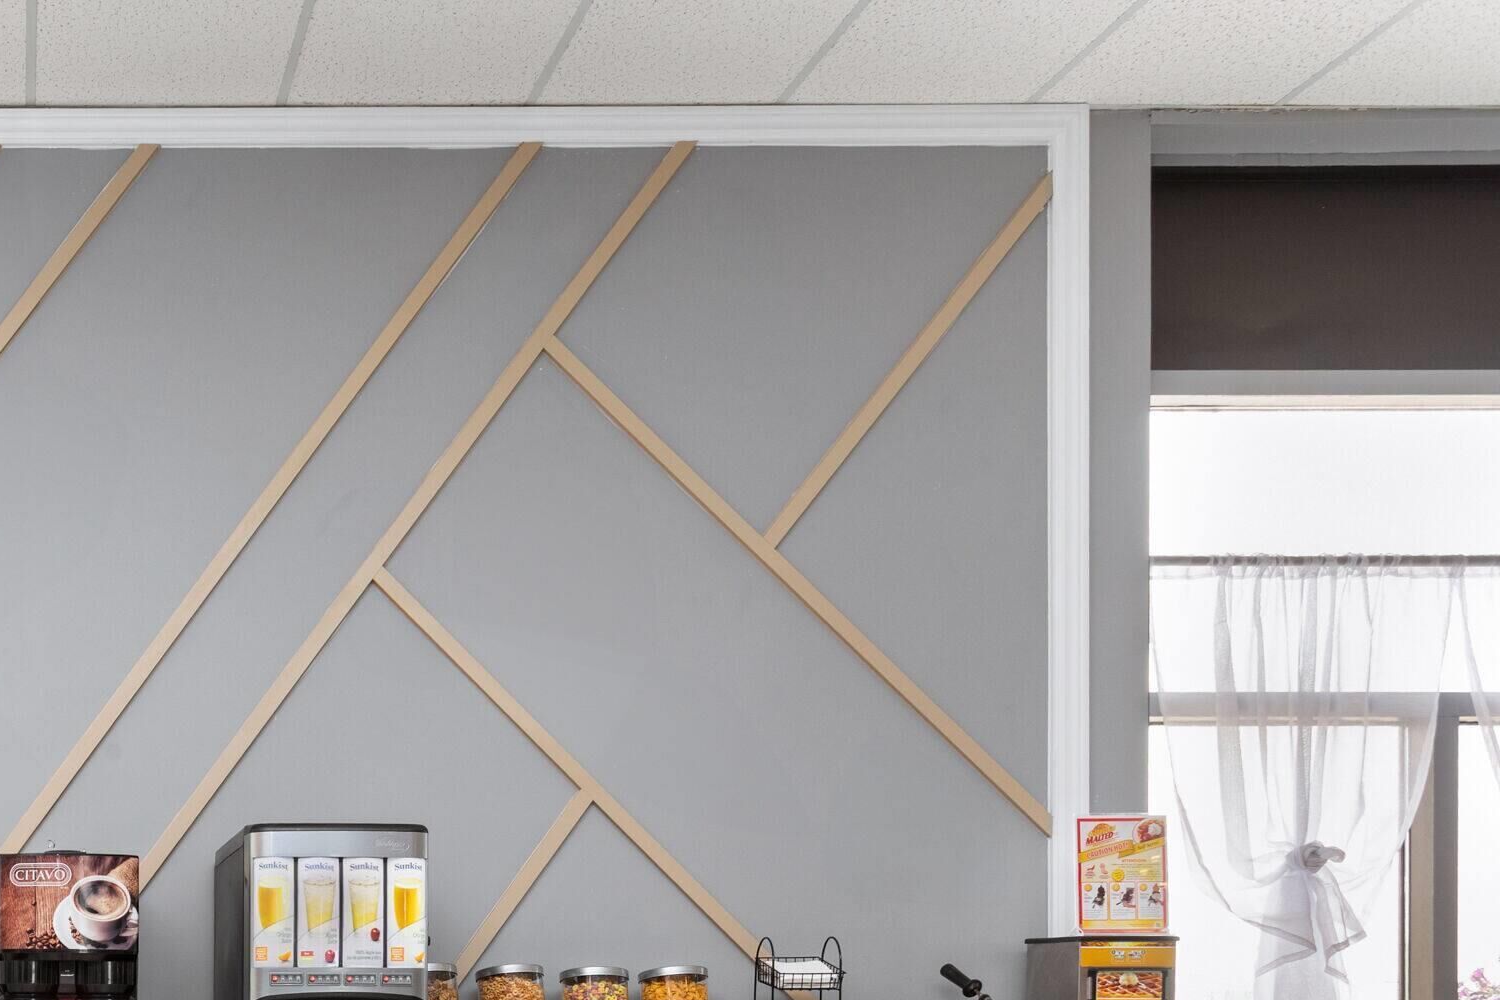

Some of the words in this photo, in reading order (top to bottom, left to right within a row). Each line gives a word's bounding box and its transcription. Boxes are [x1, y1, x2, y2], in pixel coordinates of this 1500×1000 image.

[1086, 845, 1113, 858] CAUTION
[258, 861, 288, 870] Sunkist
[304, 862, 334, 871] Sunkist
[349, 862, 379, 871] Sunkist
[394, 862, 422, 871] Sunkist
[14, 869, 66, 881] CITAVO
